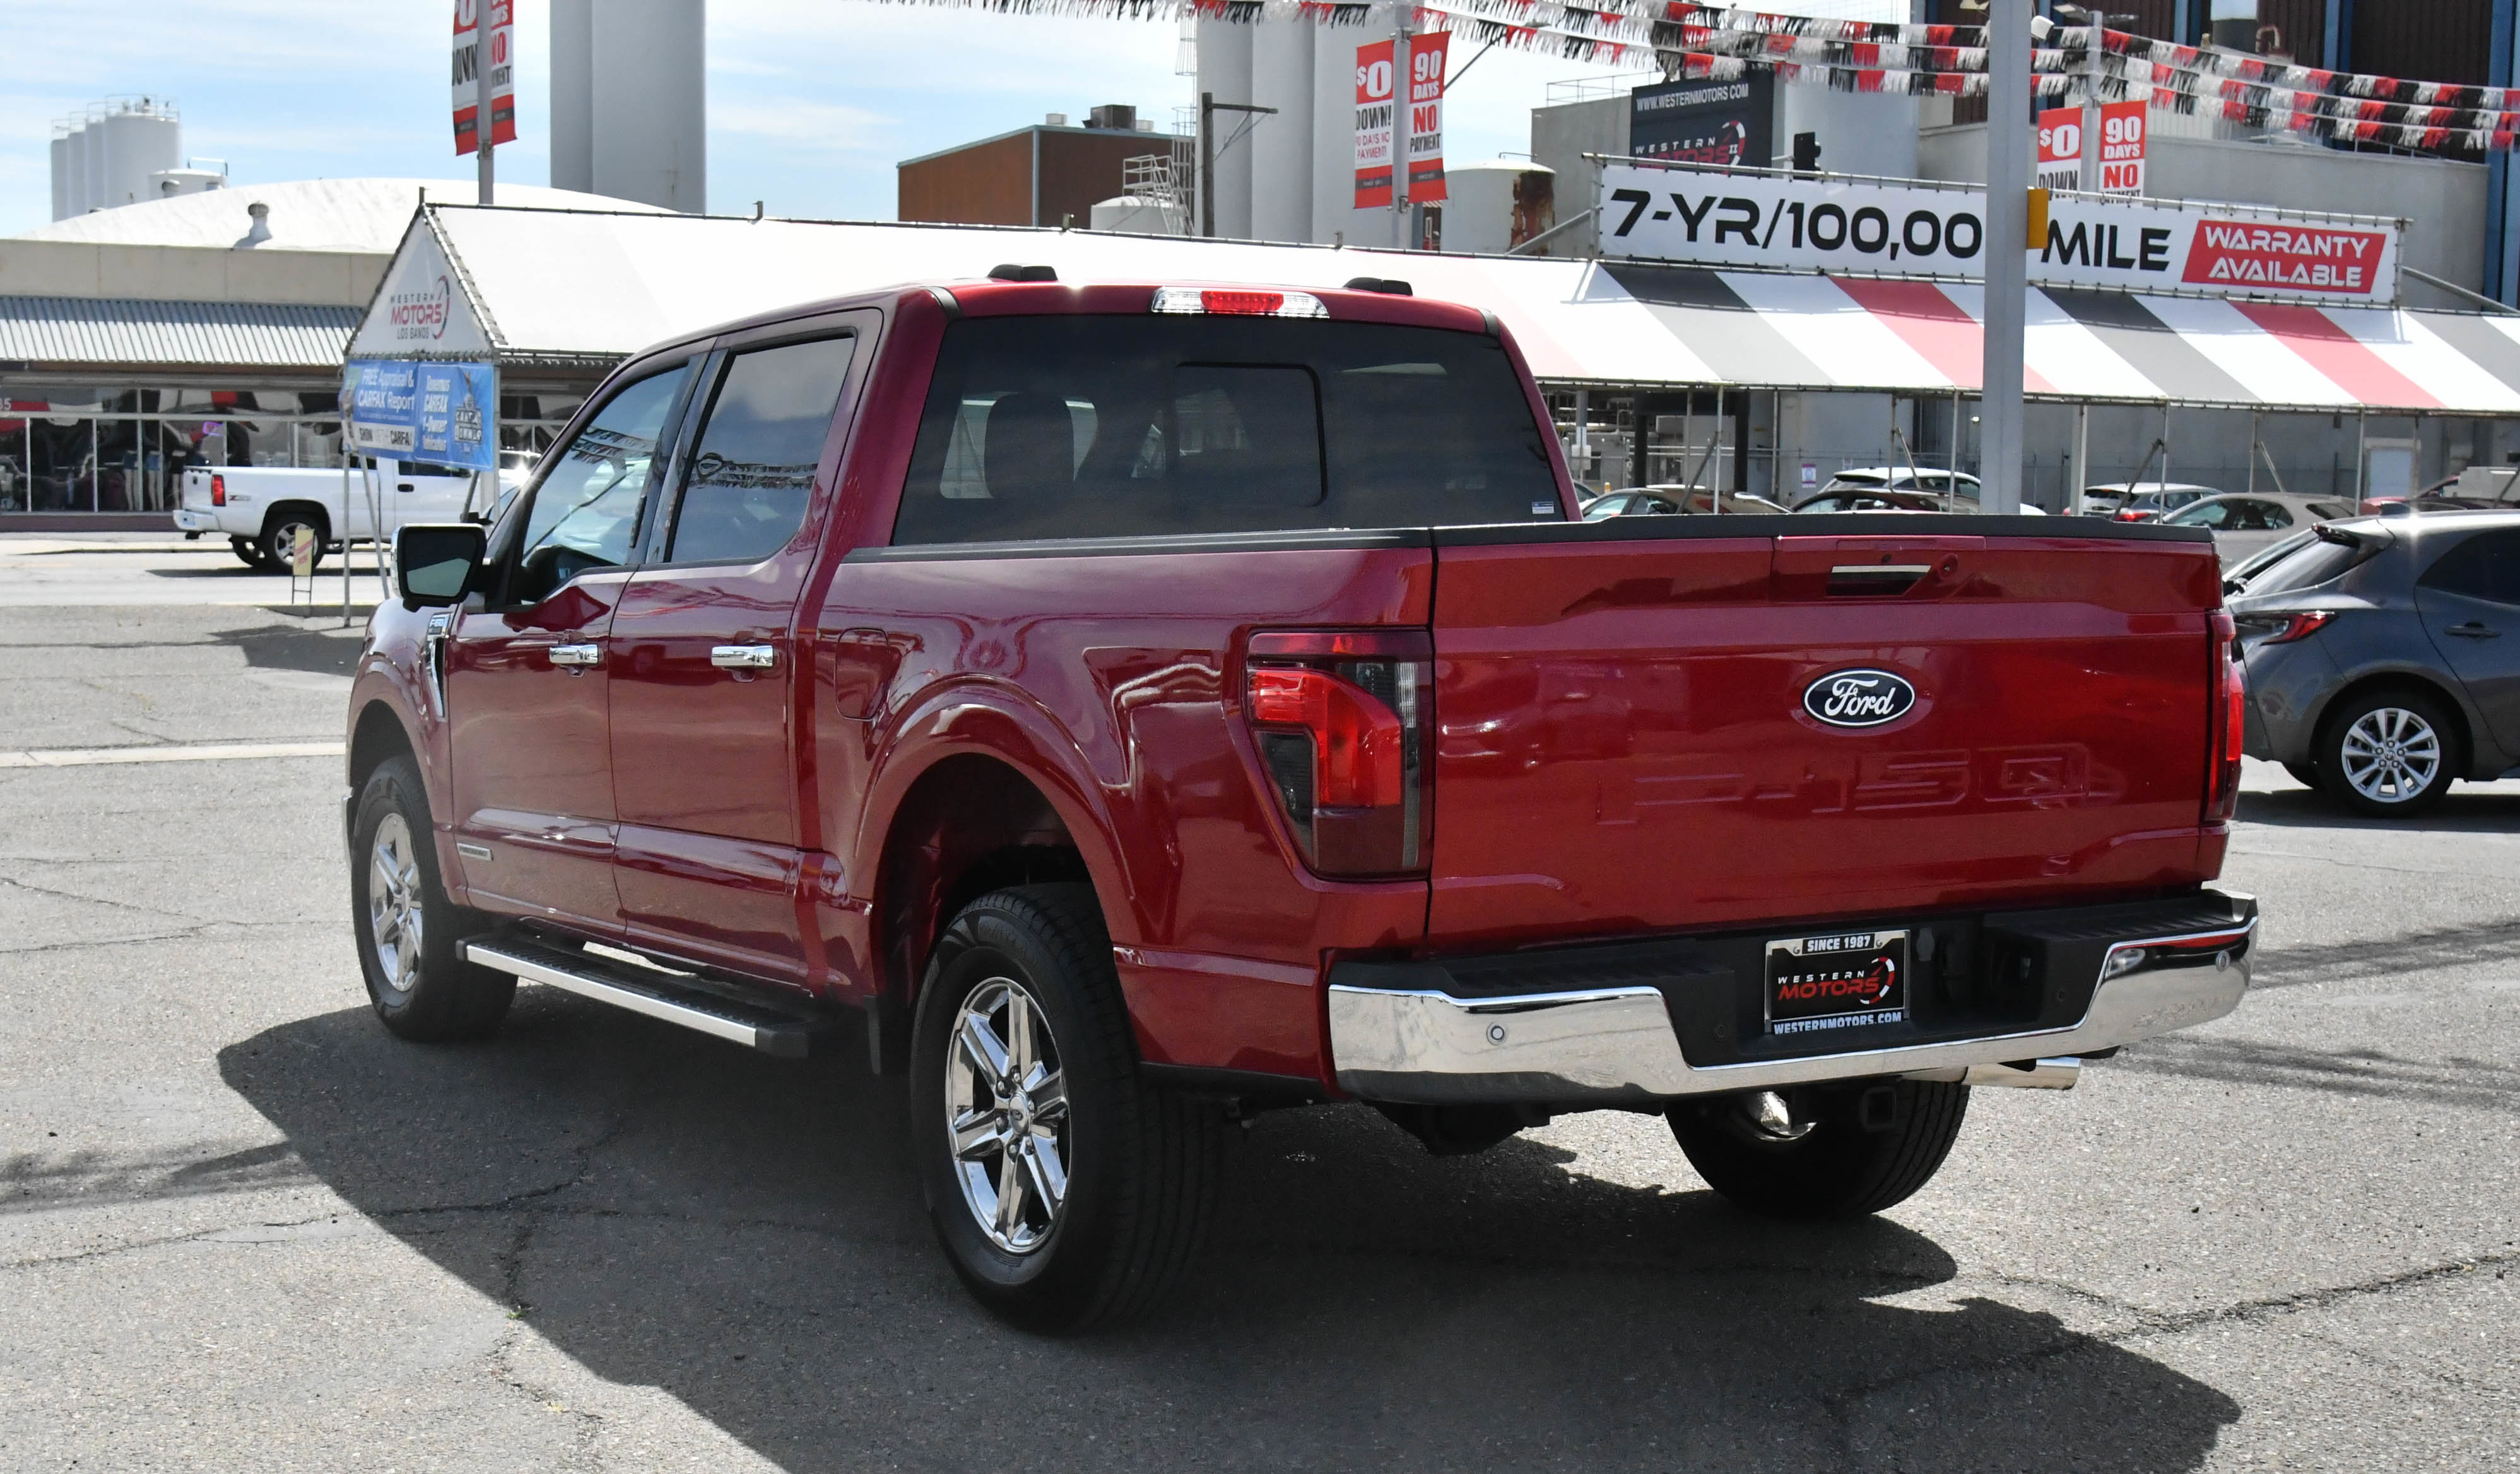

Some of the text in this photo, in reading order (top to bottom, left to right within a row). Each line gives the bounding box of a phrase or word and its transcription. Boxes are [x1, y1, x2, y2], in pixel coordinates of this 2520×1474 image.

[1415, 50, 1442, 82] 90
[1357, 60, 1392, 98] $0
[1413, 81, 1439, 100] DAYS
[1413, 104, 1437, 134] NO
[2105, 116, 2141, 143] 90
[1410, 133, 1440, 153] PAYMENT
[1635, 136, 1716, 155] WESTERN
[2039, 124, 2080, 157] $0
[2104, 143, 2140, 159] DAYS
[2104, 164, 2138, 188] NO
[1610, 189, 2172, 271] 7-YR/100,00 MILE
[2205, 225, 2369, 259] WARRANTY
[2208, 257, 2362, 287] AVAILABLE
[391, 293, 435, 304] WESTERN
[391, 304, 442, 325] MOTORS
[397, 327, 429, 339] LOS BANOS
[362, 368, 379, 386] FREE
[358, 389, 415, 414] CARFAX Report
[1825, 678, 1896, 716] Ford
[1807, 935, 1871, 952] SINCE 1987
[1778, 970, 1865, 984] WESTERN
[1778, 977, 1880, 1000] MOTORS
[1774, 1011, 1902, 1035] WESTERNMOTORS.COM
